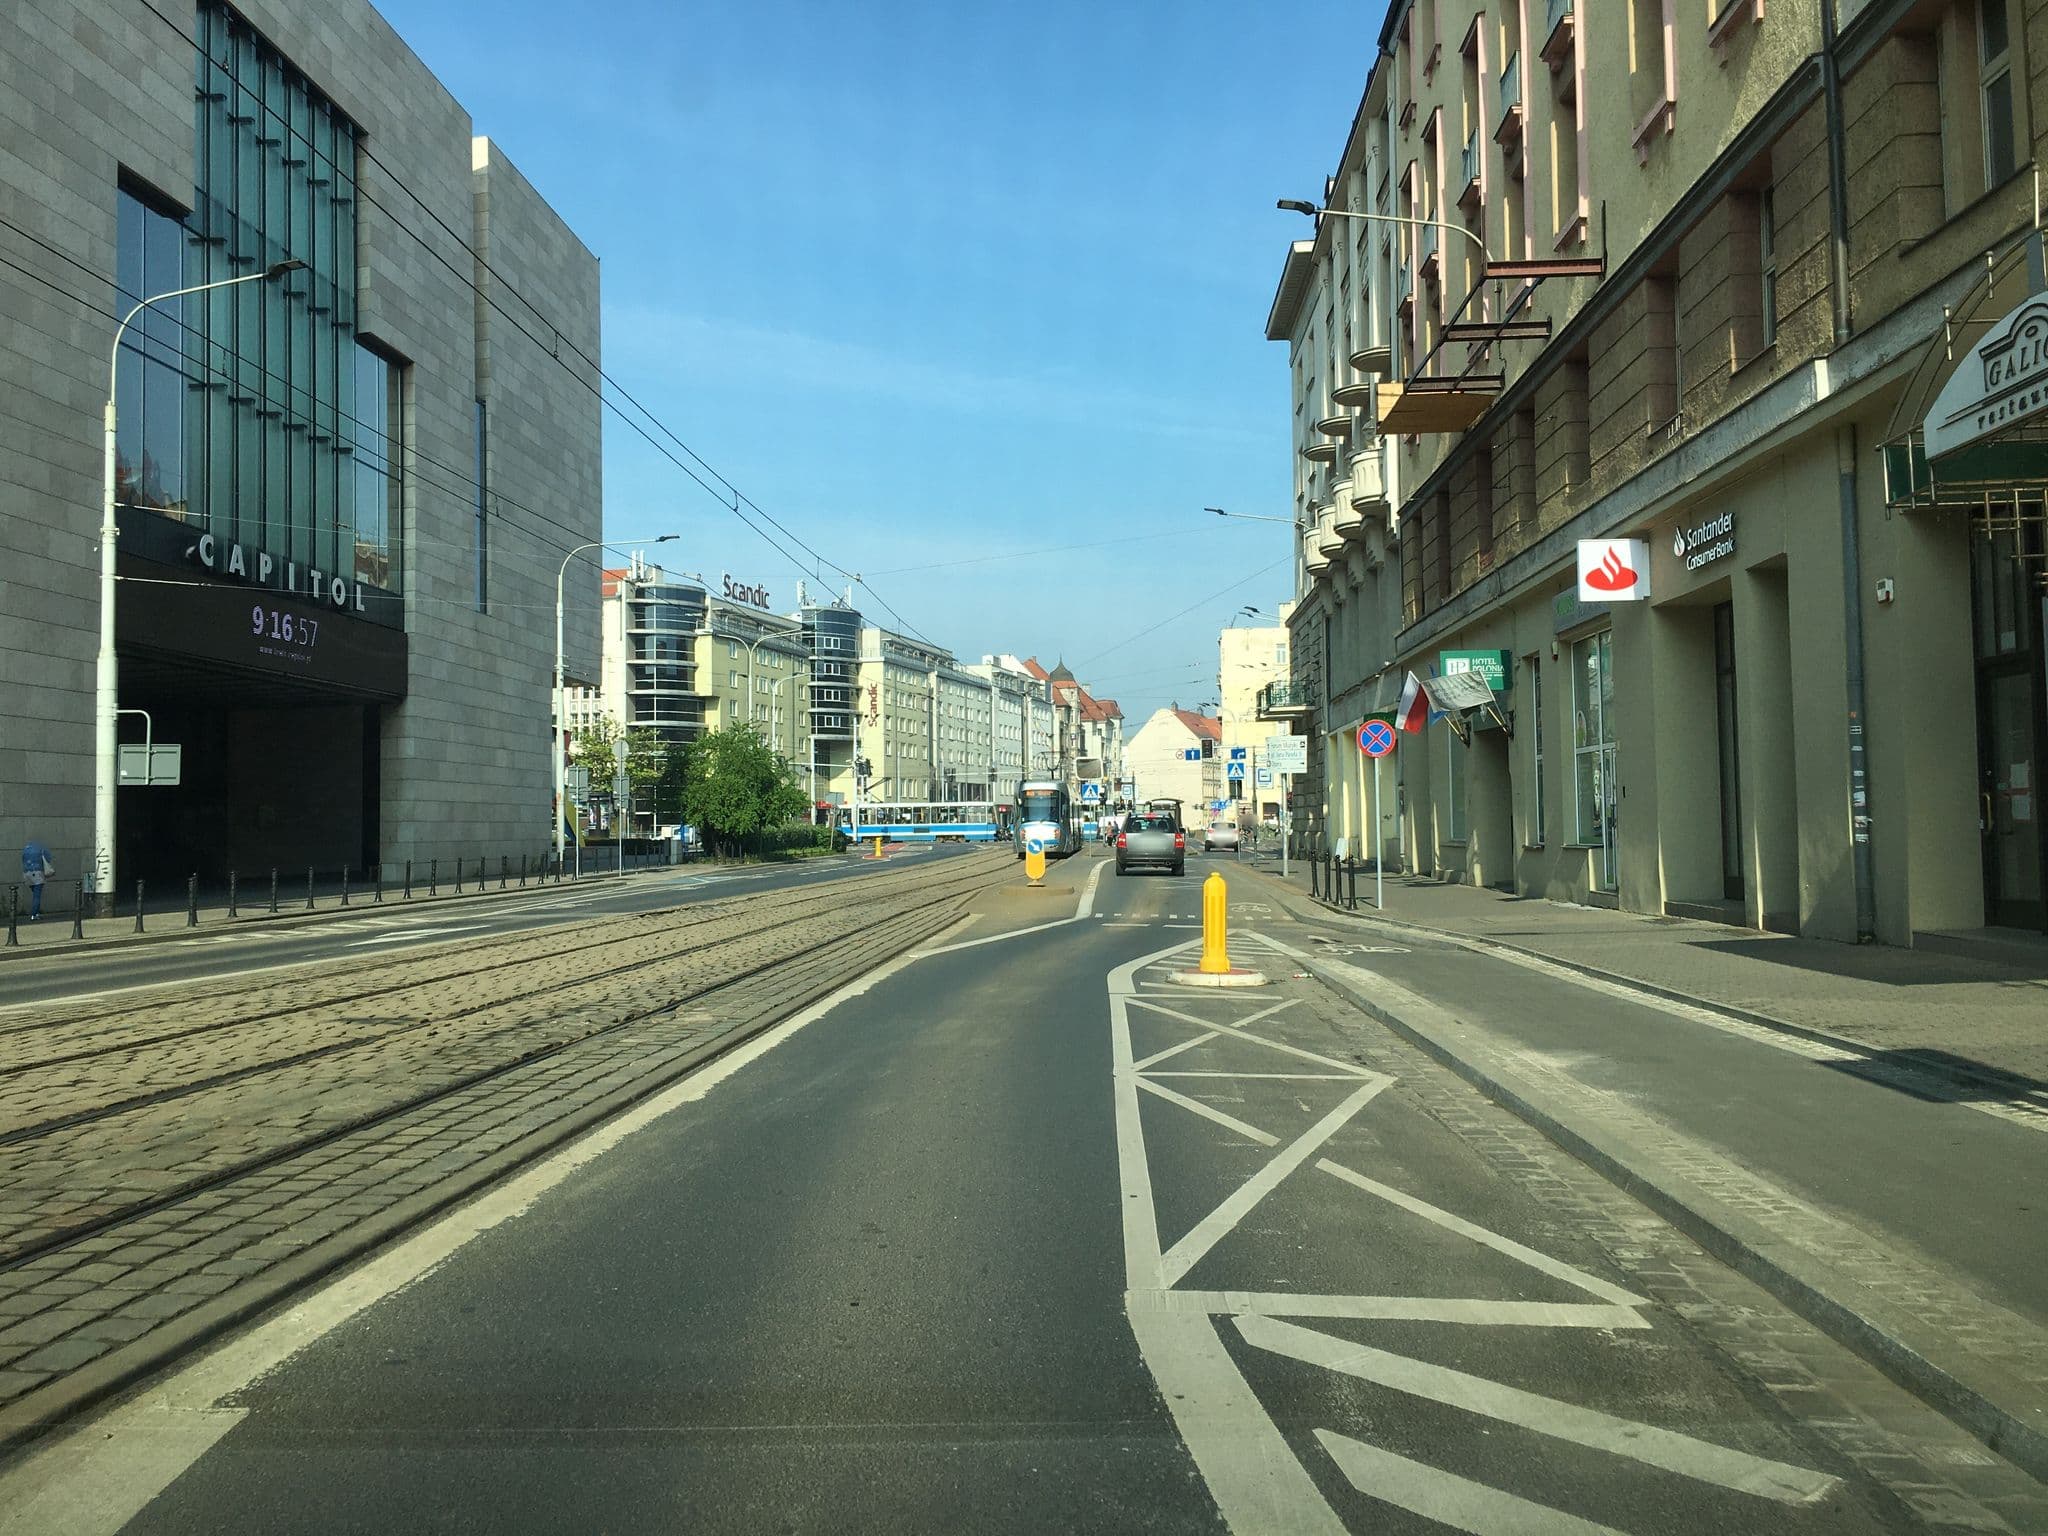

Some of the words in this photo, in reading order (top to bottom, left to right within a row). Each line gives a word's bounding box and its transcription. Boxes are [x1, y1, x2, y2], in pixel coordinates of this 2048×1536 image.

[1687, 512, 1733, 551] Santander
[200, 534, 365, 611] CAPITOL
[723, 573, 770, 610] Scandic
[252, 605, 318, 647] 9:16:57
[1472, 664, 1505, 672] POLONIA
[867, 682, 878, 728] Scandic
